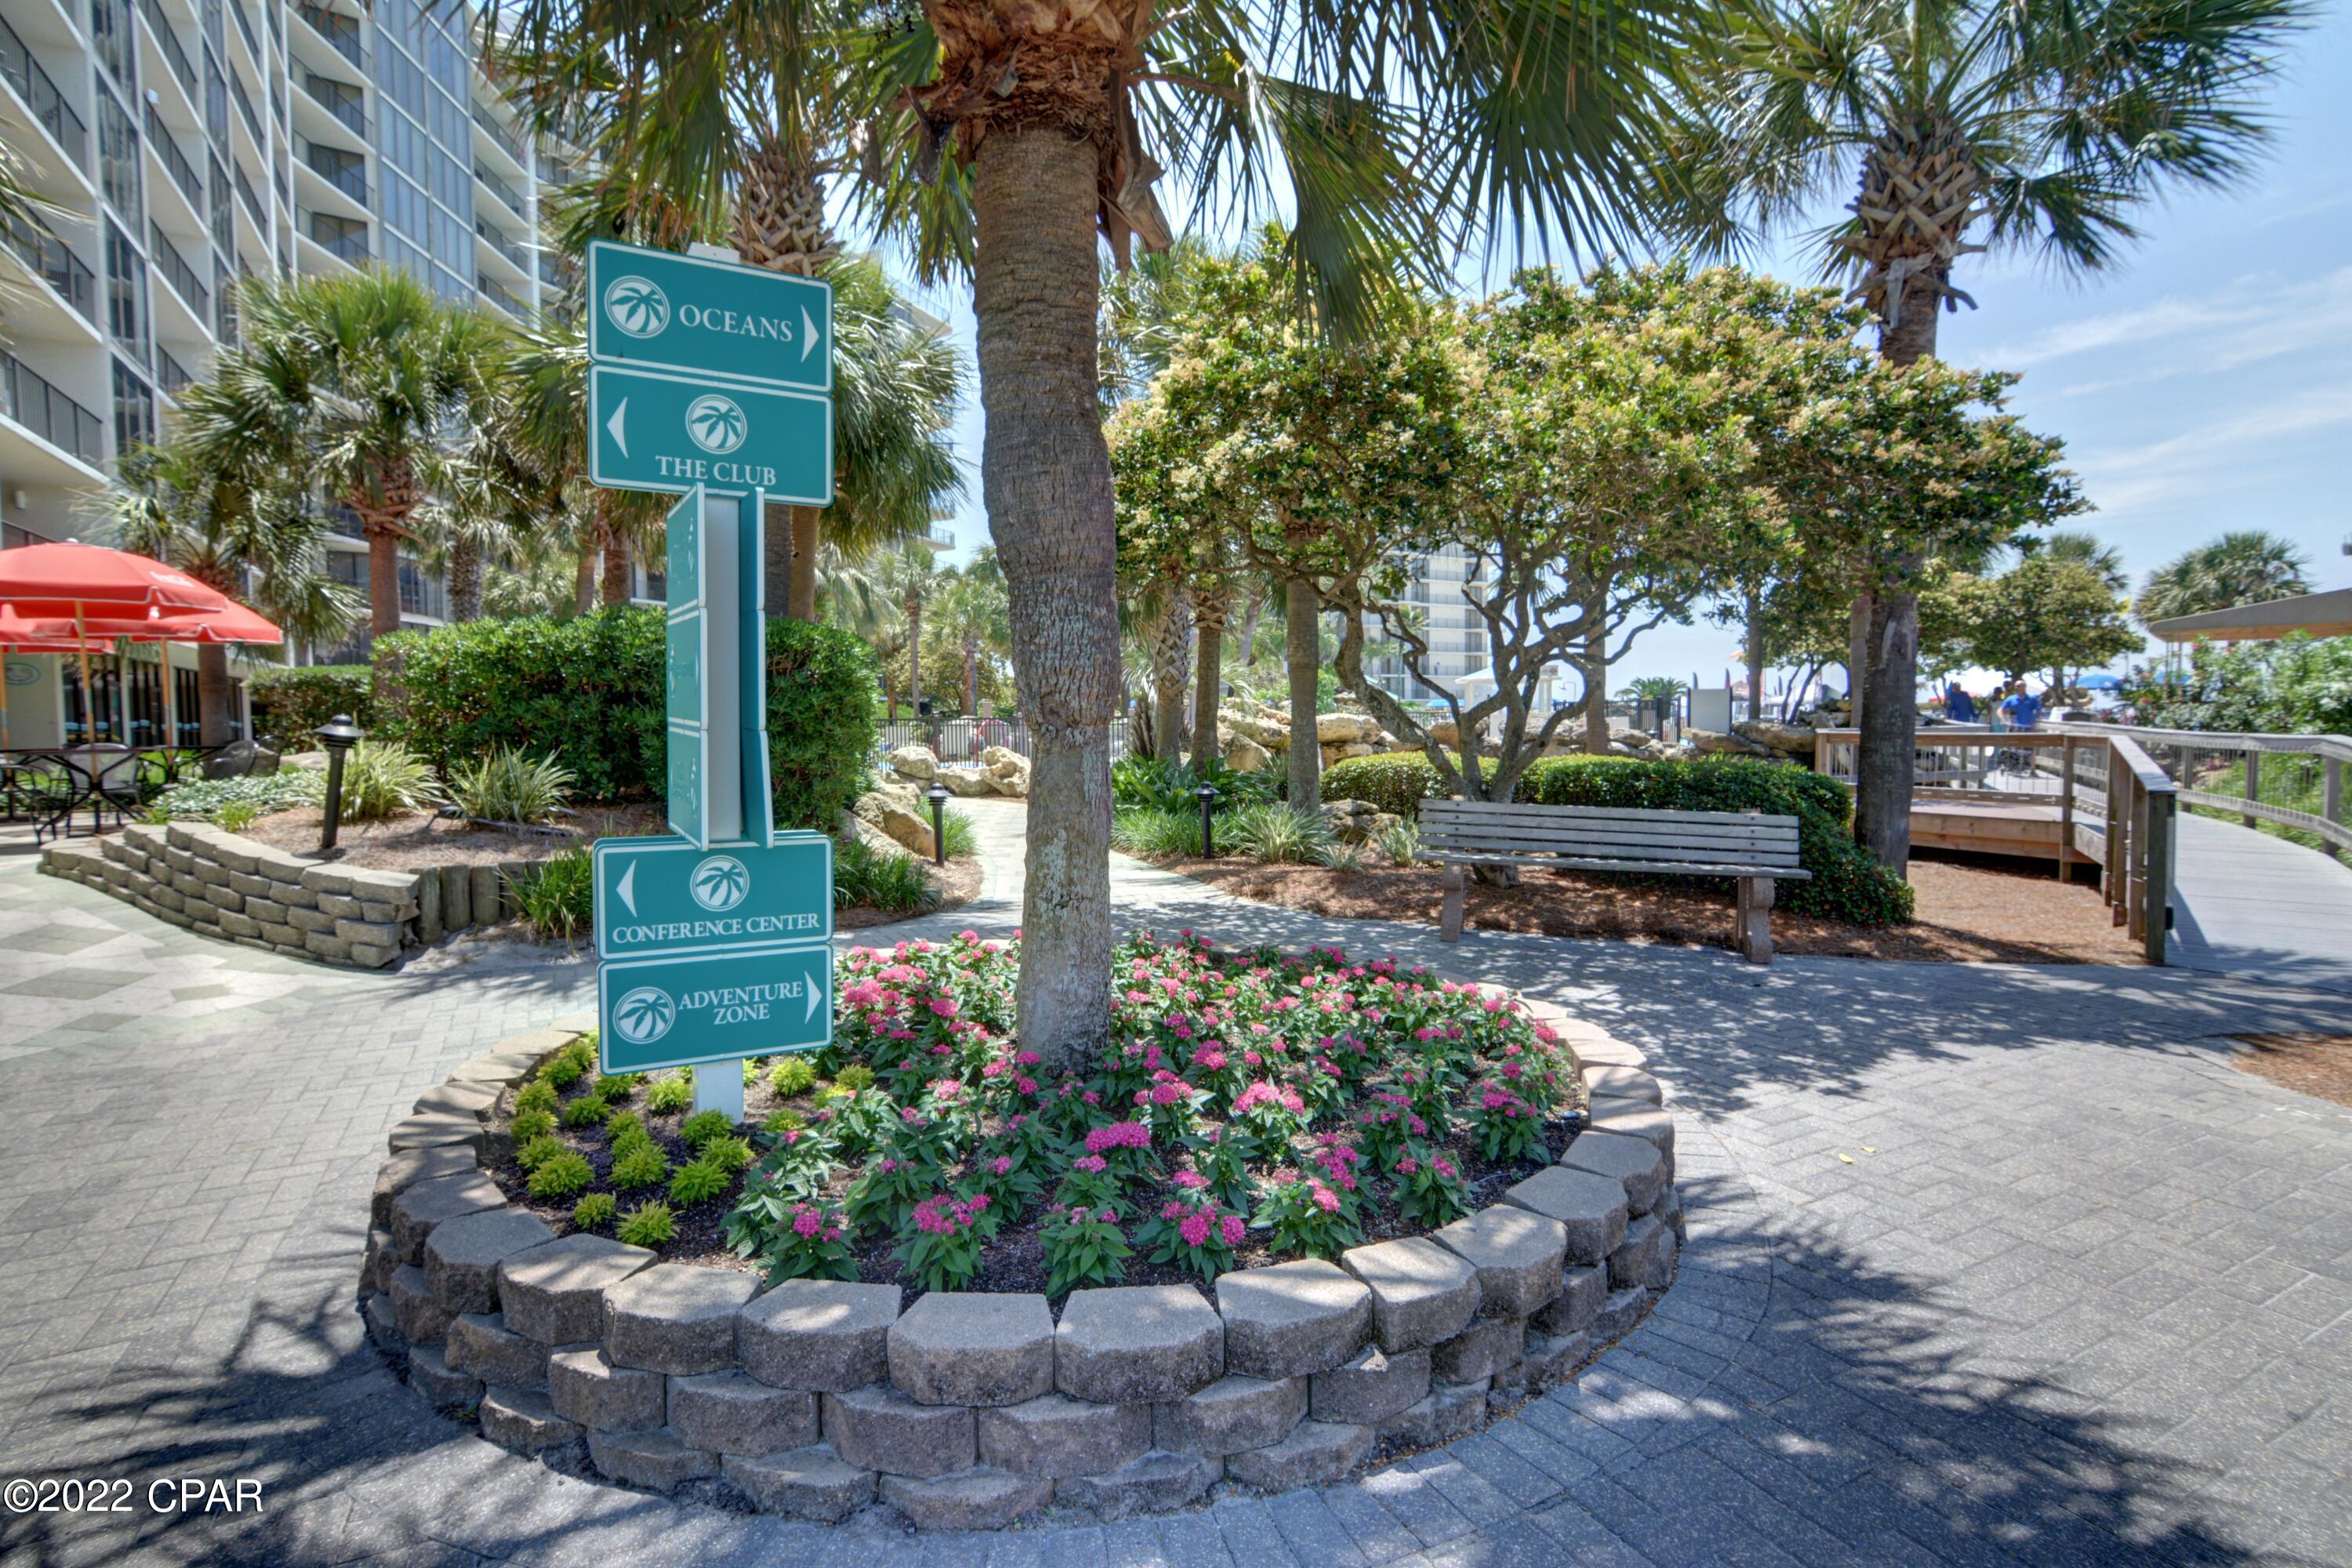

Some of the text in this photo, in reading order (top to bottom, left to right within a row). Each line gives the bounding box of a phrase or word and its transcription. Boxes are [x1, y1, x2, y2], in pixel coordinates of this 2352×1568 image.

[679, 304, 793, 342] OCEANS
[655, 456, 776, 486] THE CLUB
[612, 913, 820, 944] CONFERENCE CENTER
[678, 982, 803, 1011] ADVENTURE
[713, 1004, 770, 1025] ZONE
